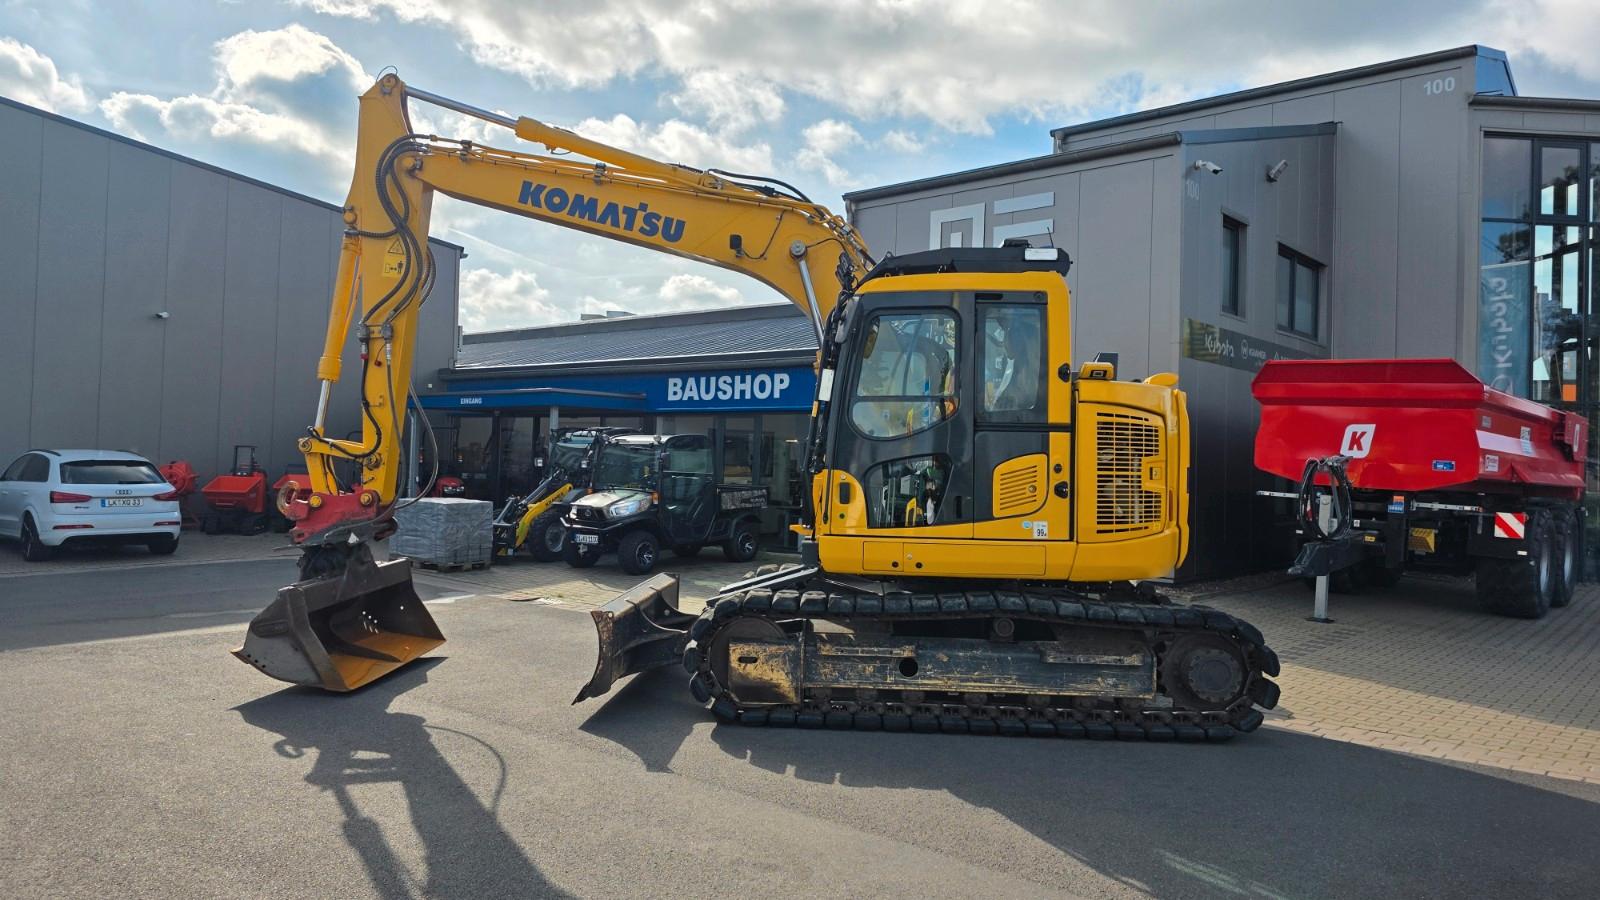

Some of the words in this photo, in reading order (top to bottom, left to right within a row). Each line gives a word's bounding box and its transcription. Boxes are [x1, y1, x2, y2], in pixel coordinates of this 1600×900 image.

[1424, 77, 1455, 95] 100
[518, 180, 686, 243] KOMATSU
[1205, 334, 1234, 357] Kubota
[667, 373, 790, 401] BAUSHOP
